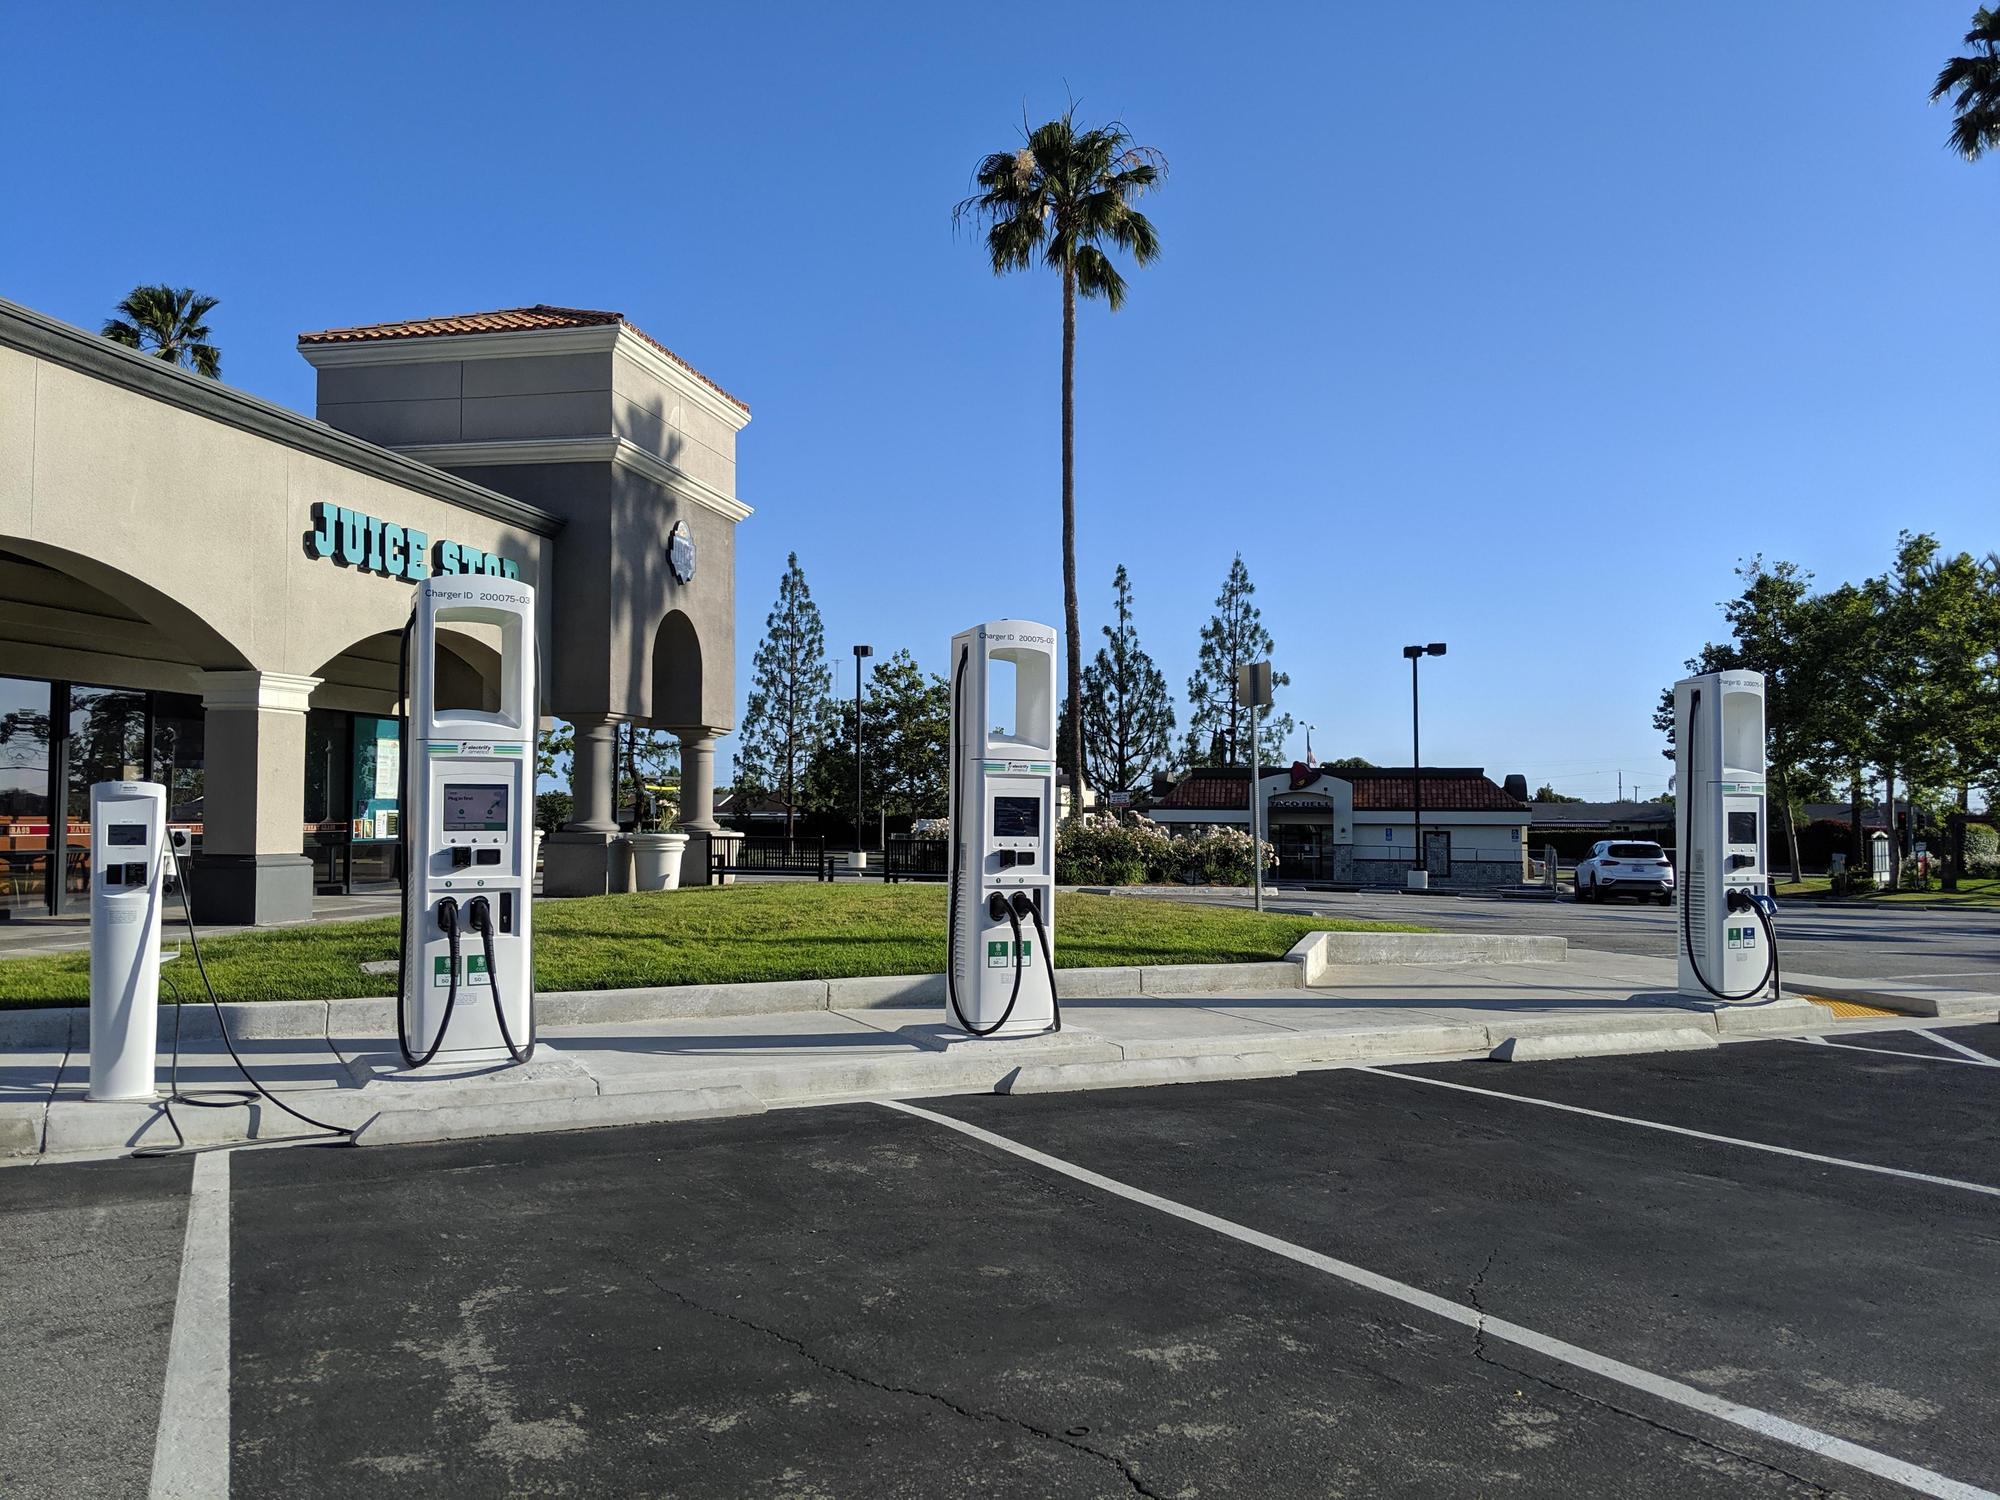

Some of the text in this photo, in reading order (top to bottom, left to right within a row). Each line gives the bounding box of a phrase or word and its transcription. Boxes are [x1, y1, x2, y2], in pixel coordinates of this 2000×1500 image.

[306, 502, 429, 583] JUICE
[425, 589, 530, 604] Charger ID 200075-03
[979, 632, 1006, 640] Charger
[1019, 635, 1054, 644] 200075-02
